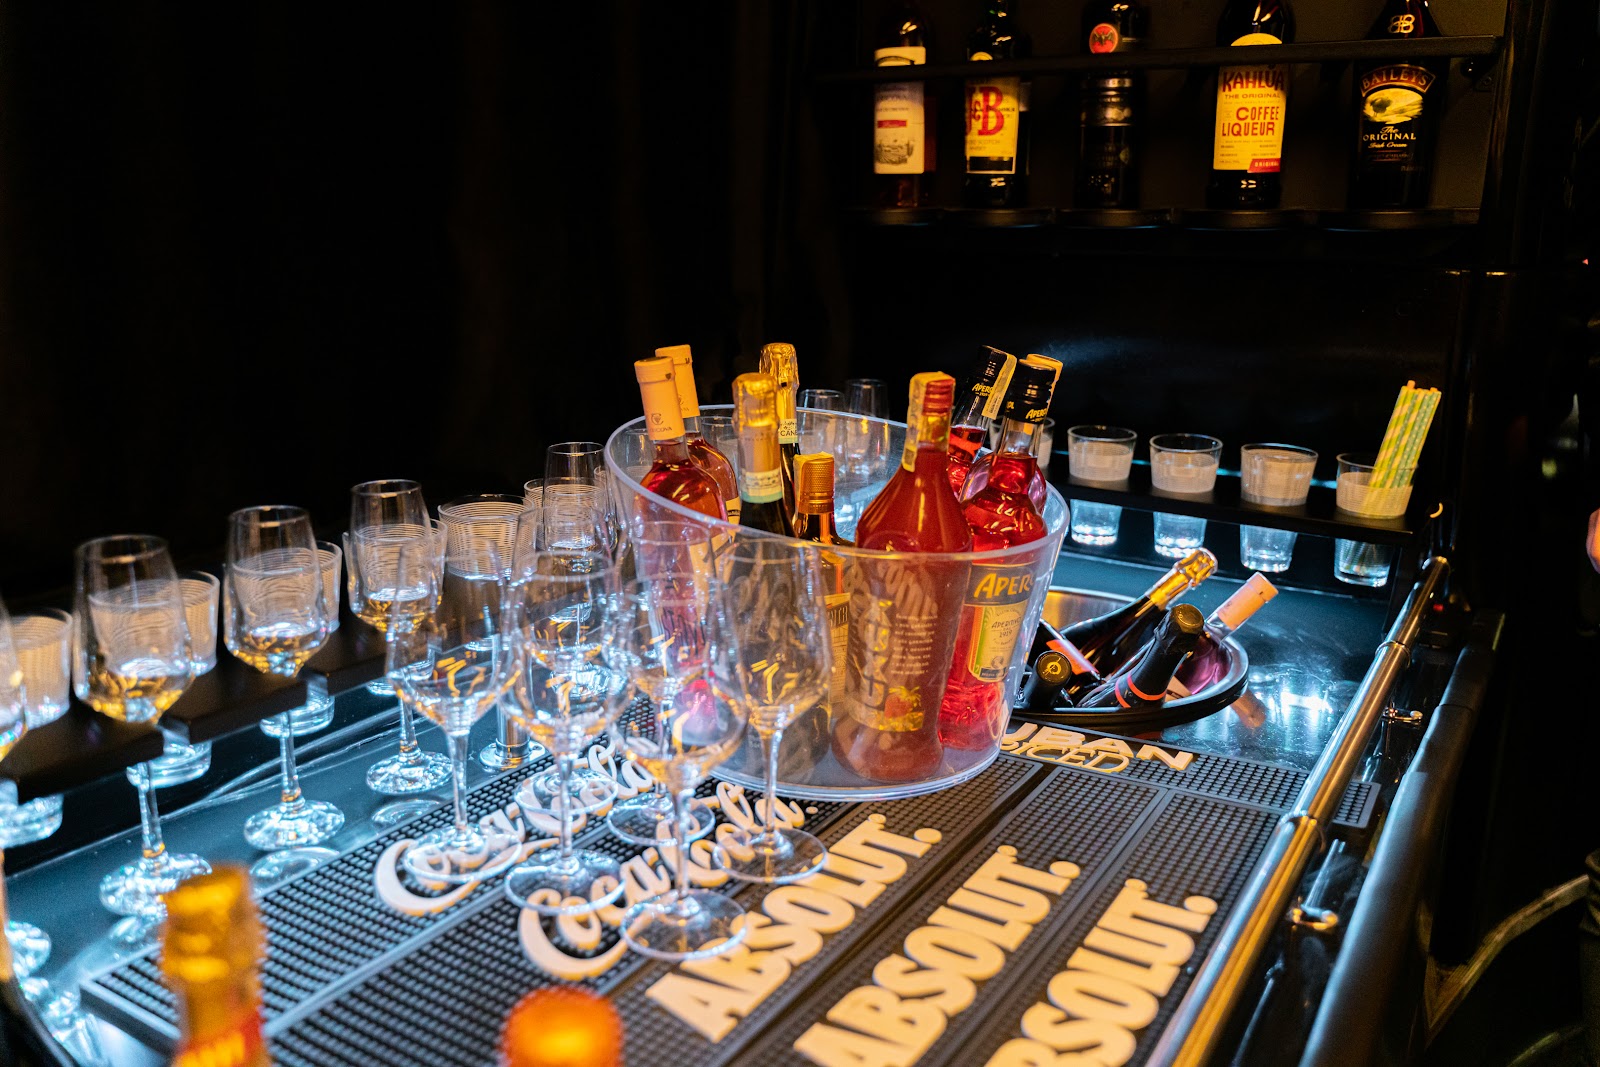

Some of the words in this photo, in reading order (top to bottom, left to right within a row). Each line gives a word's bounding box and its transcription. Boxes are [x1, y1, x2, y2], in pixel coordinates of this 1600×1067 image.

[1362, 67, 1429, 90] BAILEYS
[1236, 106, 1280, 121] COFFEE
[1221, 121, 1276, 137] LIQUEUR
[1380, 126, 1400, 135] The
[1362, 132, 1417, 142] ORIGINAL
[971, 383, 994, 395] APERO
[1025, 408, 1047, 420] APERO
[973, 572, 1033, 600] APER
[1002, 722, 1194, 771] UBAN
[985, 879, 1218, 1067] SOLUT.
